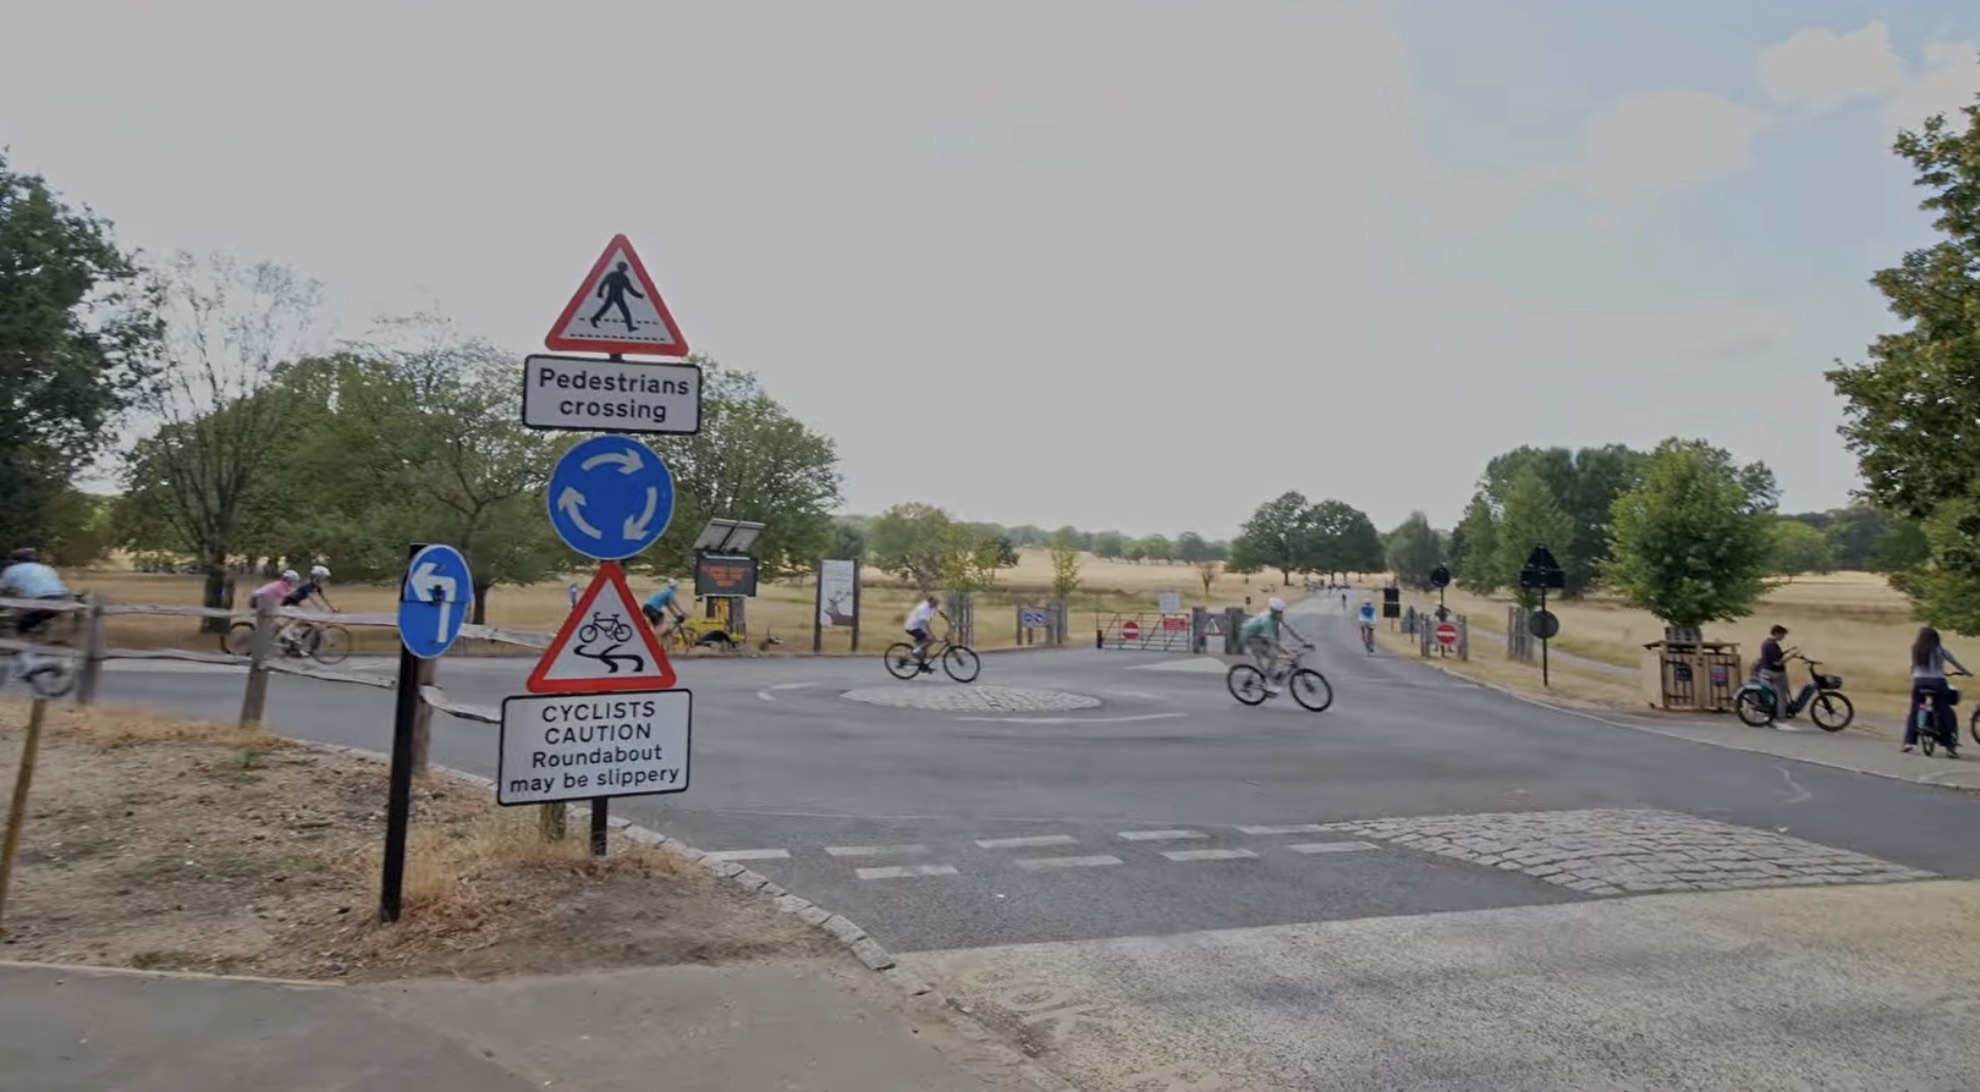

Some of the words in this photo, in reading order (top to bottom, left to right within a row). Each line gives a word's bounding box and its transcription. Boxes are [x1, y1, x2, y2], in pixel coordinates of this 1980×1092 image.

[539, 368, 690, 395] Pedestrians
[560, 400, 667, 423] crossing
[542, 701, 656, 723] CYCLISTS
[545, 723, 652, 745] CAUTION
[532, 745, 663, 768] Roundabout
[509, 776, 555, 794] may
[563, 772, 589, 789] be
[596, 767, 680, 787] slippery
